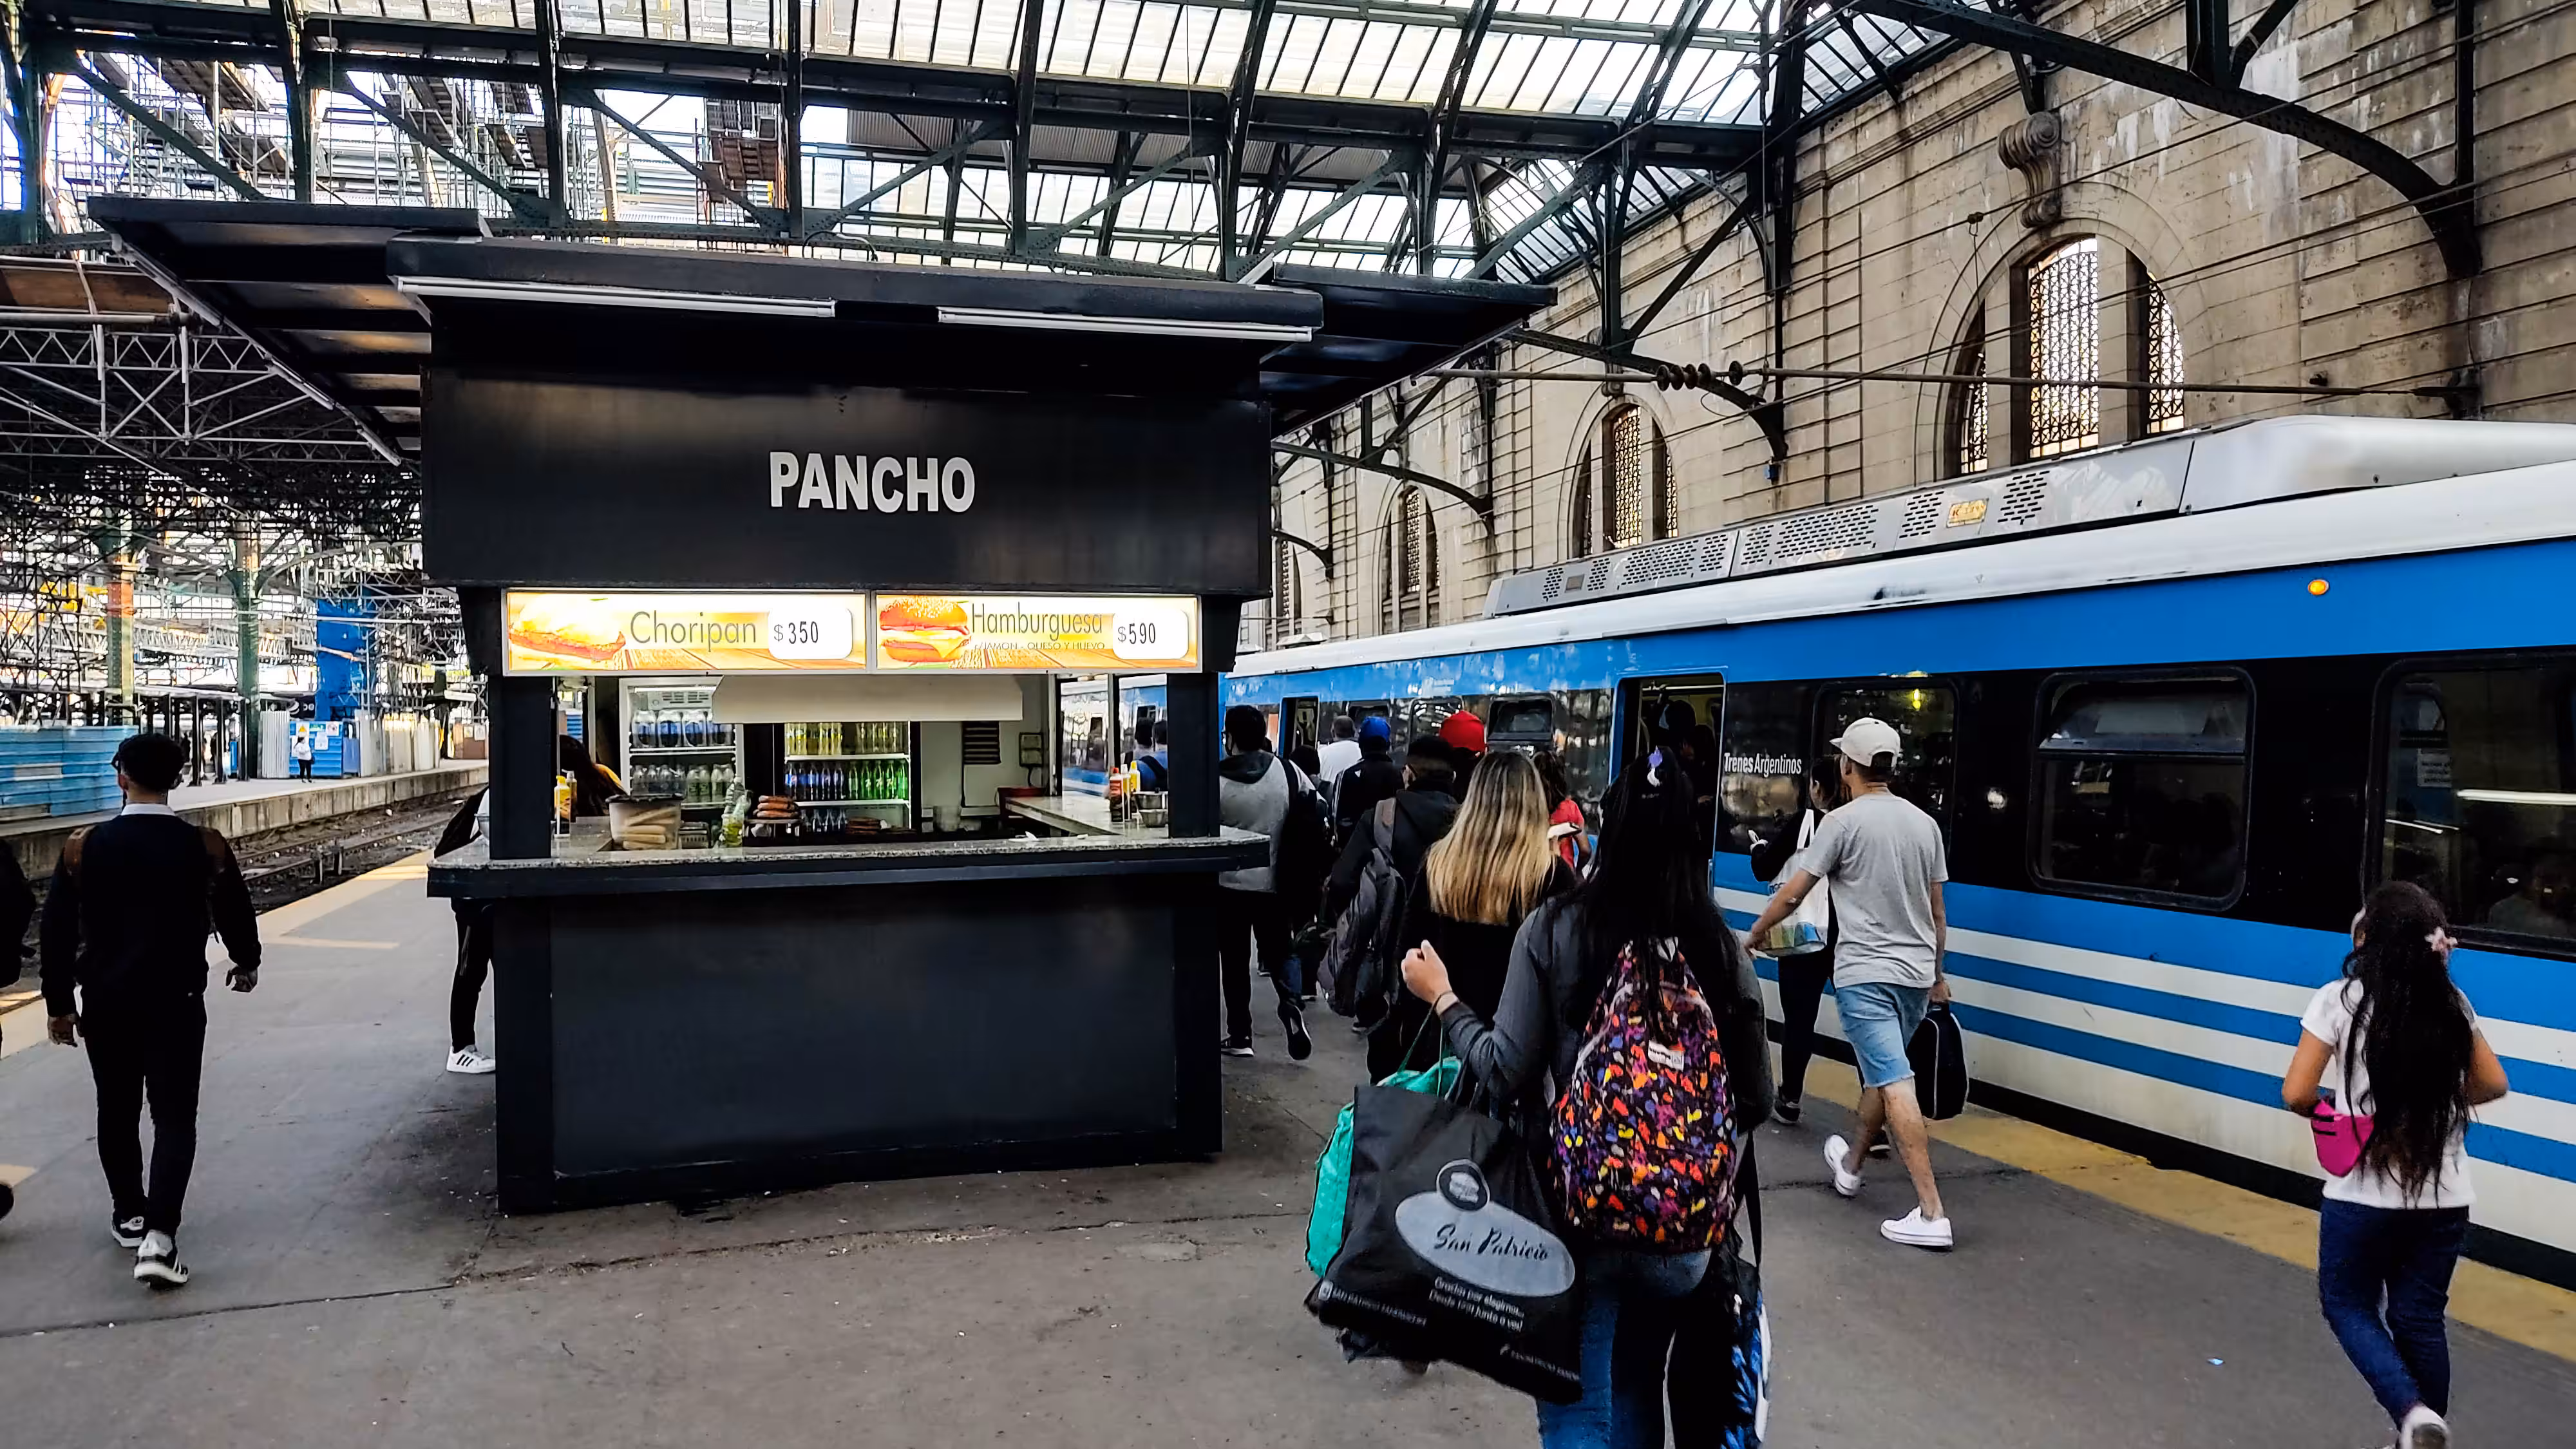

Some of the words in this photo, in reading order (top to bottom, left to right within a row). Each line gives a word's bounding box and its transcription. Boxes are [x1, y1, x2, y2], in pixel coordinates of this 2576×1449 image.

[770, 451, 975, 513] PANCHO
[630, 611, 756, 652] Choripan
[971, 601, 1102, 641] Hamburguesa
[1027, 641, 1061, 650] QUESO
[1064, 641, 1070, 650] Y
[1724, 752, 1754, 773] Trenes
[1754, 753, 1802, 778] Argentinos
[1434, 1223, 1472, 1253] San
[1477, 1227, 1549, 1261] Patricio
